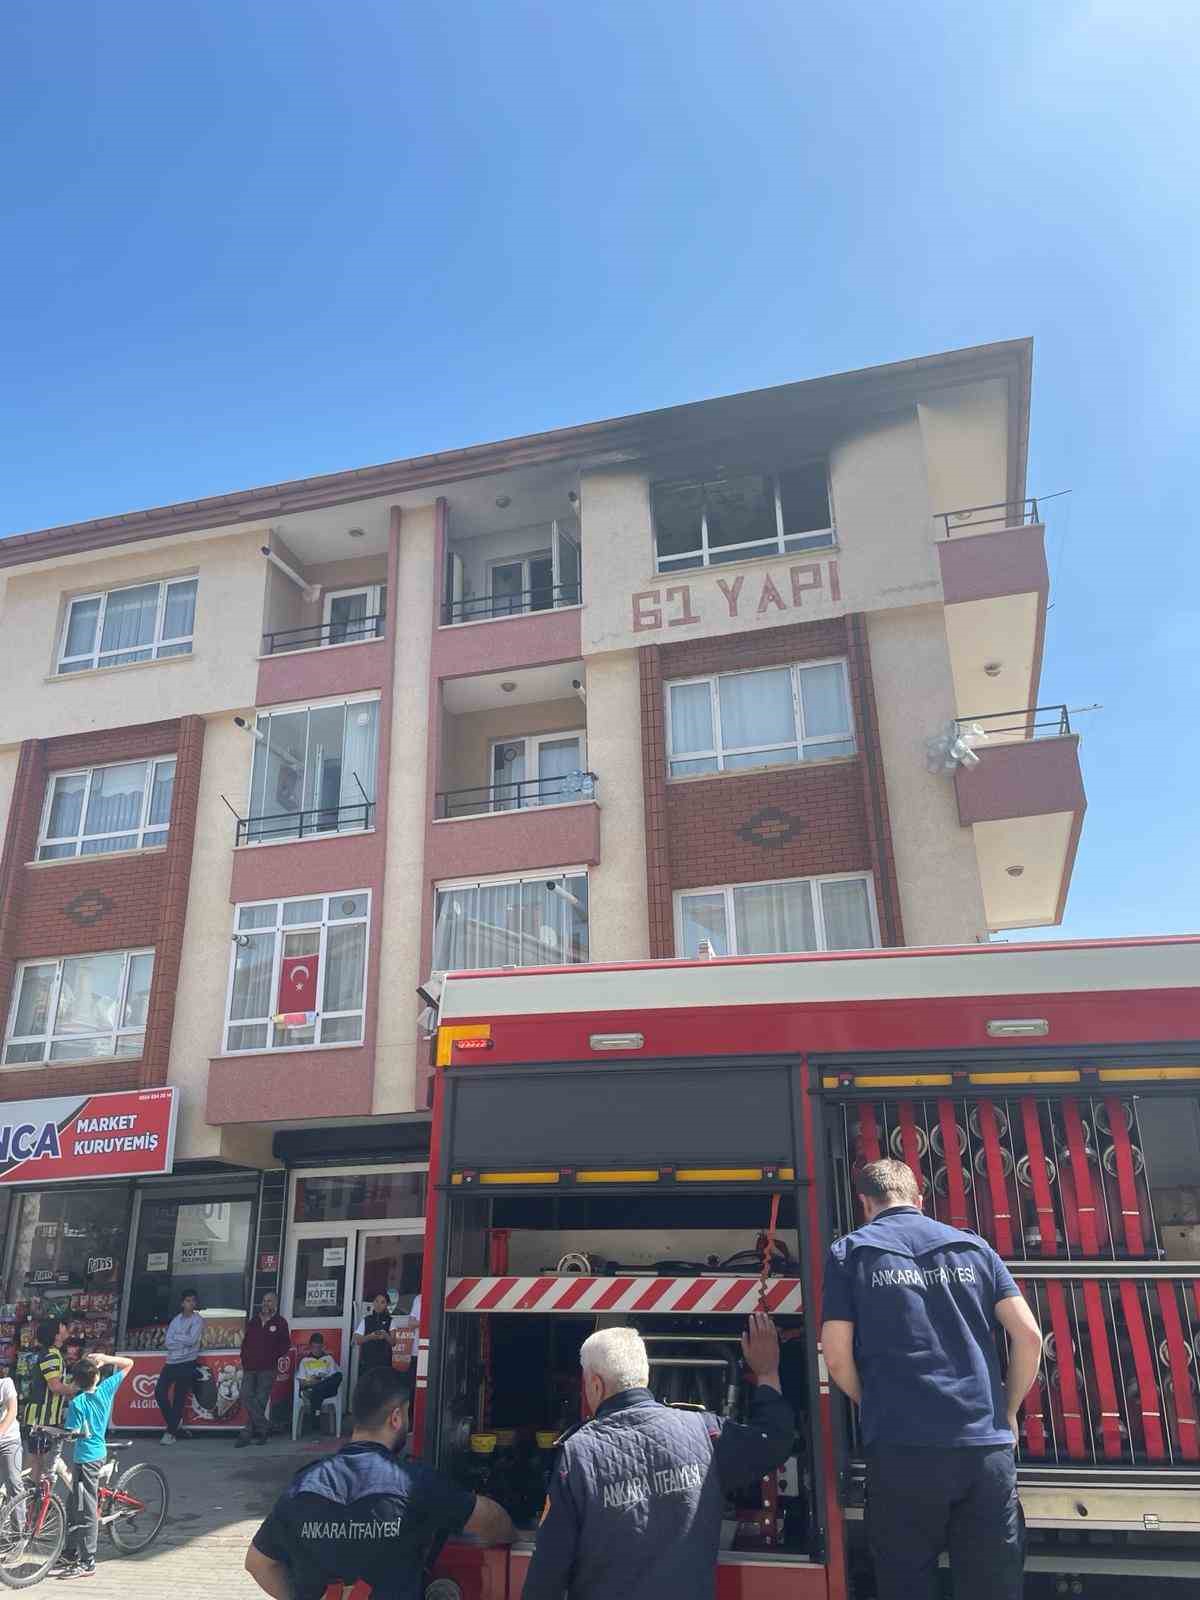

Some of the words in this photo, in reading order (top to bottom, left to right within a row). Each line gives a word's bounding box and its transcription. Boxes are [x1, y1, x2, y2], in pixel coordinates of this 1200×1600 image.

[632, 585, 700, 632] 61
[716, 561, 841, 618] YAPI
[76, 1115, 137, 1133] MARKET
[74, 1132, 159, 1155] KURUYEMİŞ
[872, 1268, 927, 1290] ANKARA
[130, 1399, 160, 1409] ALGID
[603, 1476, 651, 1508] ANKARA
[301, 1521, 347, 1539] ANKARA
